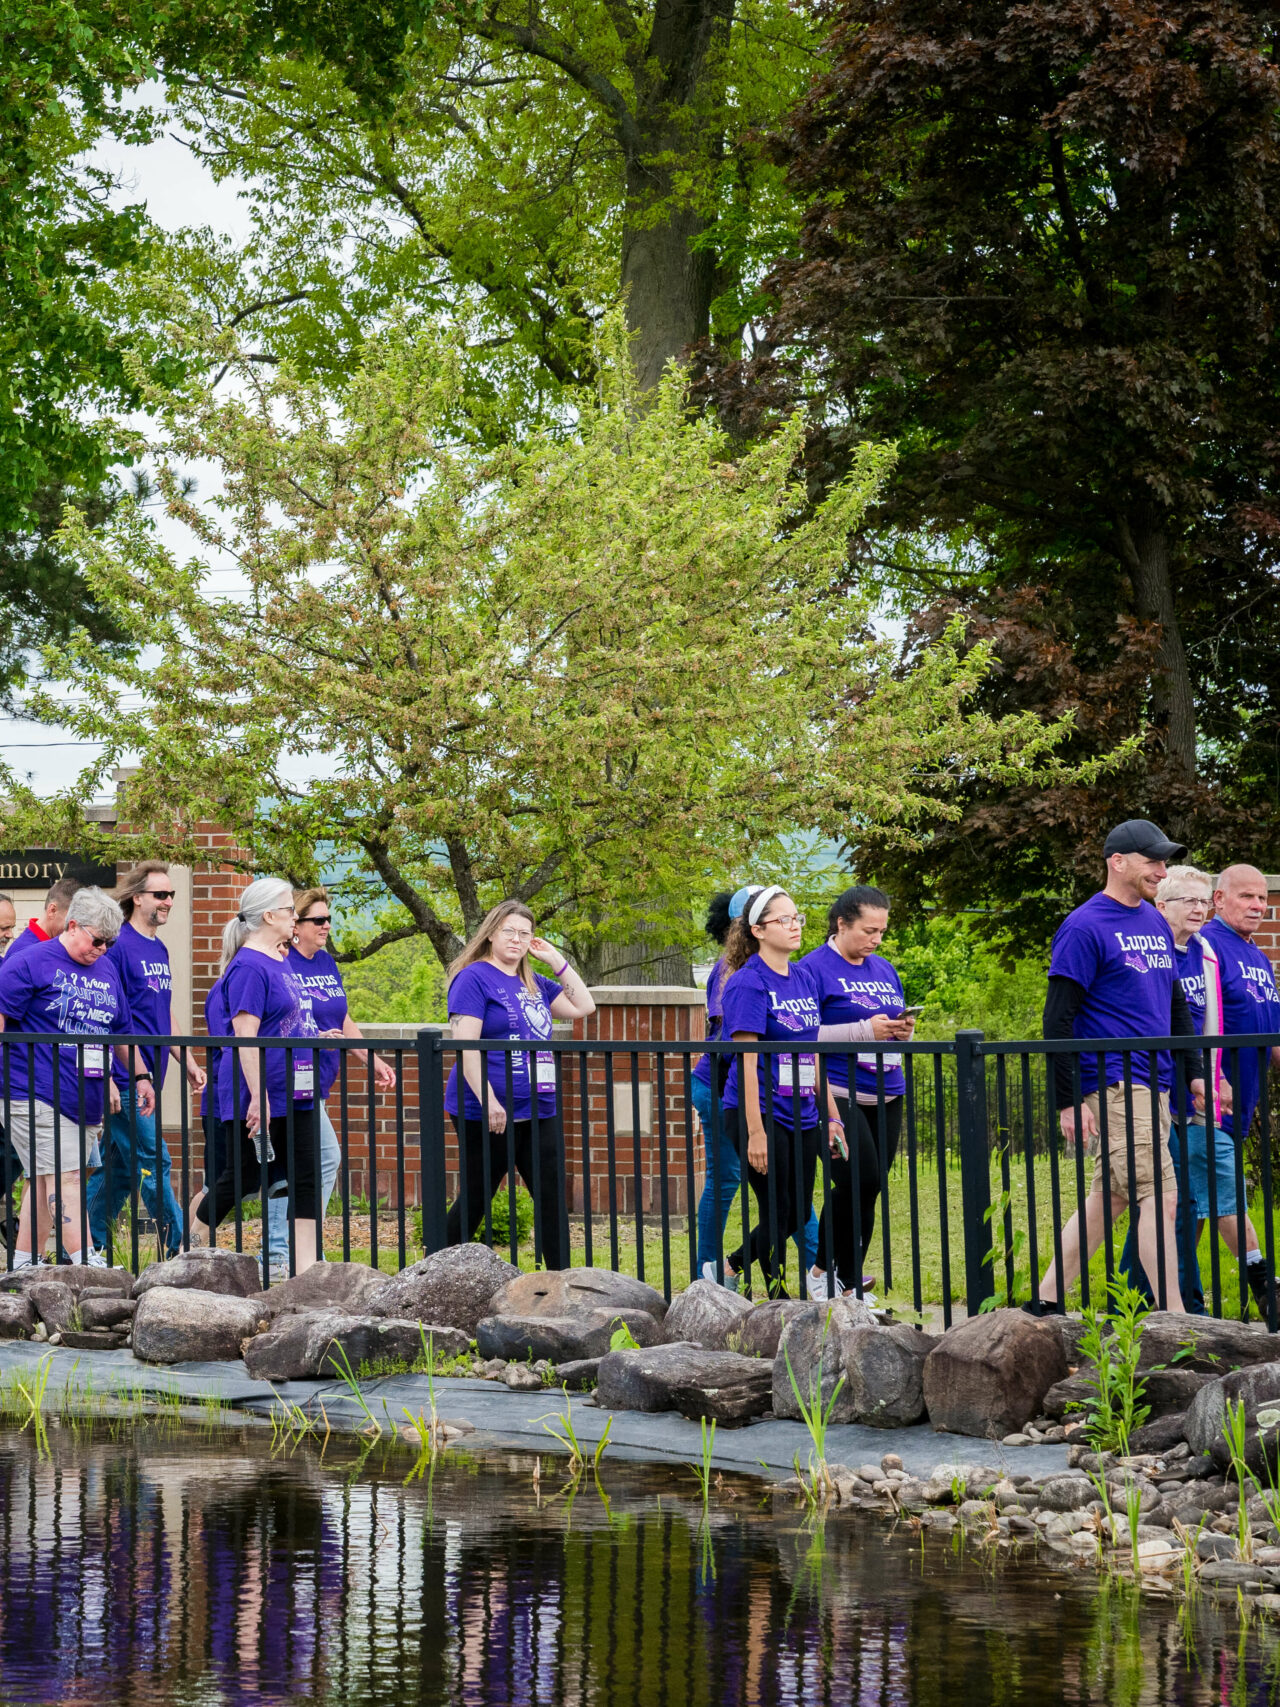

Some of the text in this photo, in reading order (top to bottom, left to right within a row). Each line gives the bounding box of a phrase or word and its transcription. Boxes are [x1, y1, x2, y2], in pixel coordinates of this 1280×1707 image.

[1114, 931, 1168, 956] Lupus
[81, 975, 111, 990] Wear
[297, 972, 339, 990] Lupus
[837, 977, 897, 997] Lupus
[1263, 986, 1280, 1004] Wa
[72, 998, 85, 1011] for
[497, 987, 521, 1030] PURPLE
[87, 1007, 115, 1024] NIEC
